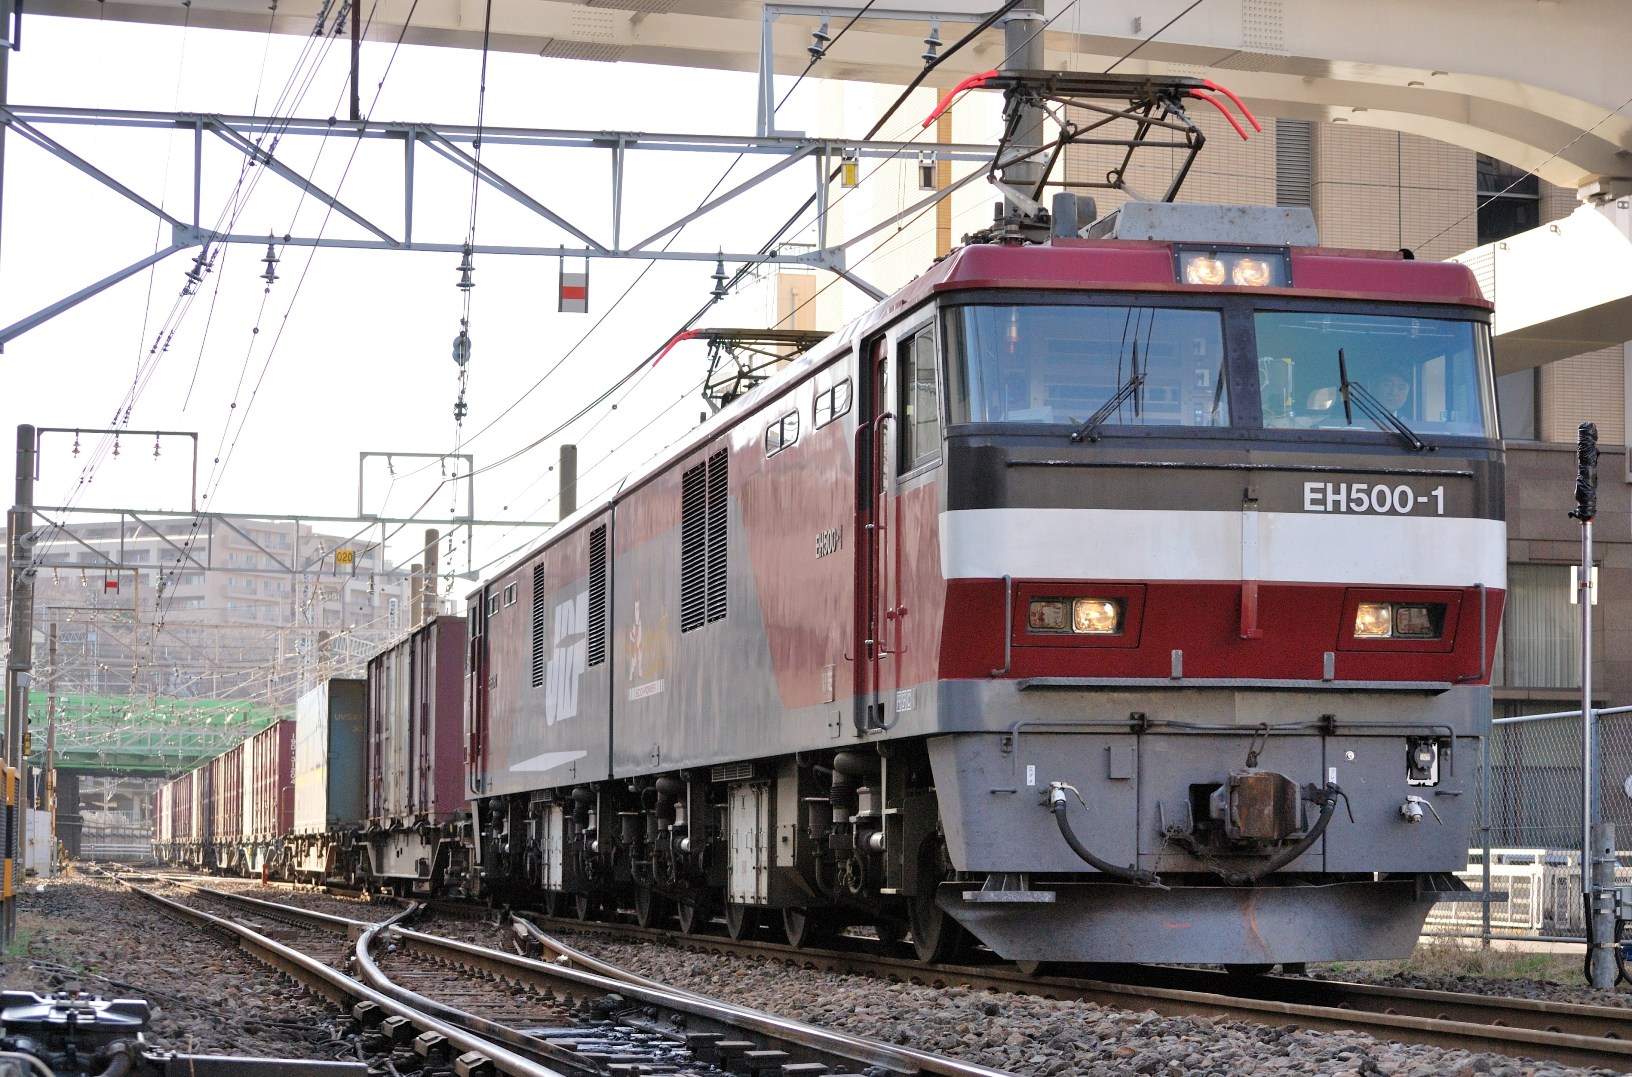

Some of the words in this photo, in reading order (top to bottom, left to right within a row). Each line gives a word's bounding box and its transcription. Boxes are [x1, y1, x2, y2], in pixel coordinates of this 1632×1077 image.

[1303, 482, 1444, 515] EH500-1
[336, 551, 353, 562] 020
[815, 524, 843, 560] EH500-1
